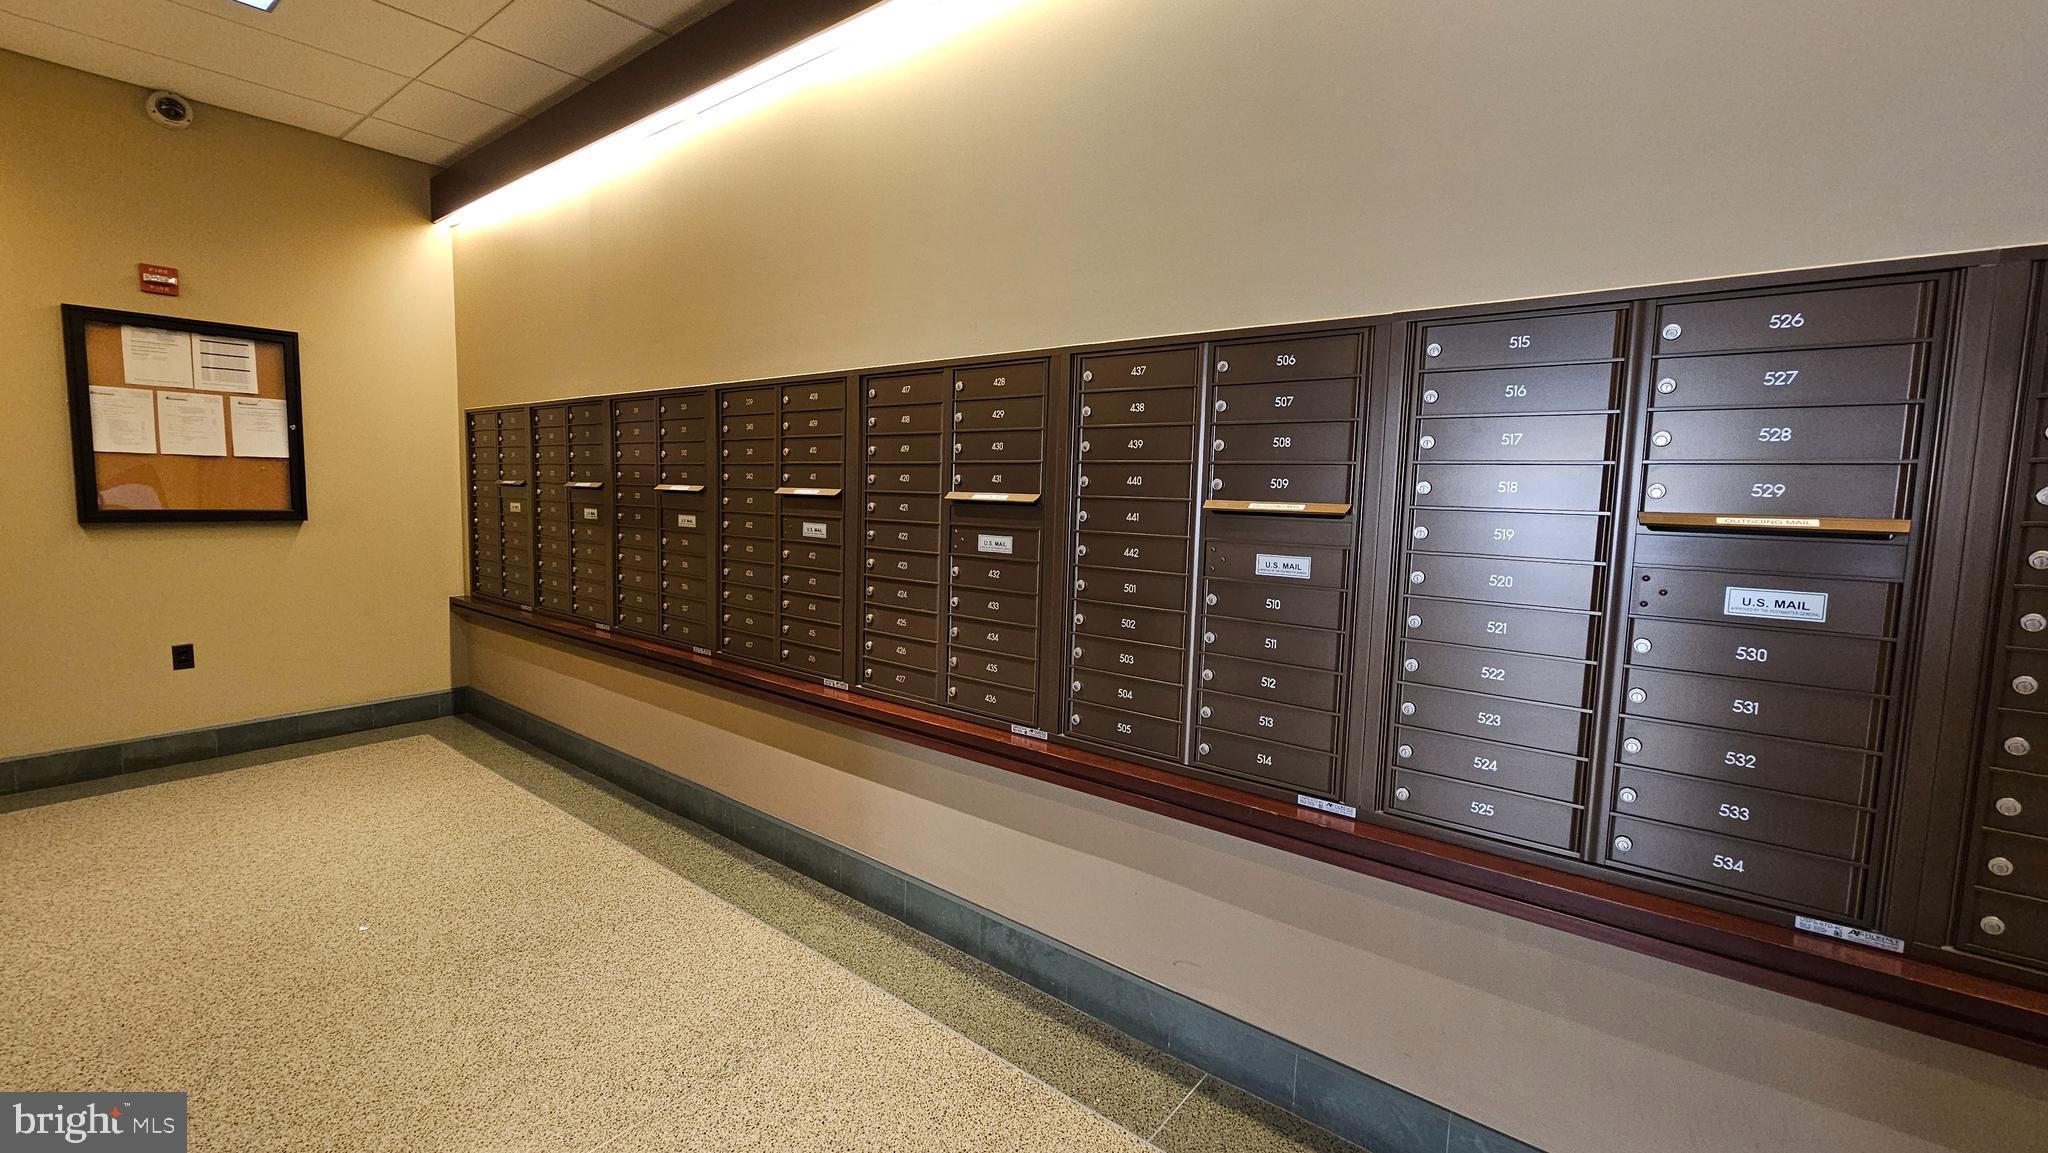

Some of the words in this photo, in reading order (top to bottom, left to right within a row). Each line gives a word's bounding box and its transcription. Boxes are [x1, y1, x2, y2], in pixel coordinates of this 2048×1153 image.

[1769, 313, 1804, 328] 526
[1509, 336, 1530, 348] 515
[1277, 355, 1296, 365] 506
[1131, 366, 1146, 375] 437
[994, 378, 1005, 386] 428
[1764, 371, 1798, 385] 527
[1505, 385, 1526, 397] 516
[1275, 396, 1293, 407] 507
[1130, 403, 1144, 412] 438
[992, 410, 1004, 418] 429
[1502, 433, 1523, 445] 517
[1759, 428, 1792, 441] 528
[992, 442, 1003, 450] 430
[1128, 440, 1143, 448] 439
[1273, 437, 1290, 447] 508
[900, 474, 909, 482] 420
[992, 475, 1001, 483] 431
[1127, 476, 1141, 485] 440
[1270, 479, 1288, 488] 509
[1498, 481, 1517, 493] 518
[1751, 484, 1785, 497] 529
[1126, 513, 1139, 521] 441
[1494, 529, 1514, 540] 519
[995, 540, 1007, 548] MAIL
[1124, 548, 1138, 557] 442
[1265, 561, 1280, 569] U.S.
[1282, 562, 1302, 571] MAIL
[988, 570, 1000, 578] 432
[1489, 575, 1513, 587] 520
[1124, 584, 1136, 593] 501
[897, 590, 907, 598] 424
[1266, 599, 1280, 609] 510
[1742, 597, 1769, 608] U.S.
[1774, 599, 1811, 611] MAIL
[1121, 619, 1135, 629] 502
[1487, 621, 1507, 634] 521
[987, 633, 998, 641] 434
[1265, 639, 1276, 648] 511
[1120, 654, 1134, 664] 503
[1736, 647, 1767, 661] 530
[986, 664, 997, 672] 435
[1481, 667, 1505, 680] 522
[1261, 677, 1276, 688] 512
[985, 695, 996, 703] 436
[1118, 689, 1132, 699] 504
[1733, 700, 1758, 714] 531
[1259, 716, 1273, 727] 513
[1478, 712, 1500, 726] 523
[1117, 723, 1131, 733] 505
[1257, 754, 1272, 765] 514
[1474, 757, 1497, 771] 524
[1725, 752, 1756, 768] 532
[1471, 802, 1494, 816] 525
[1719, 804, 1749, 820] 533
[1713, 855, 1744, 872] 534
